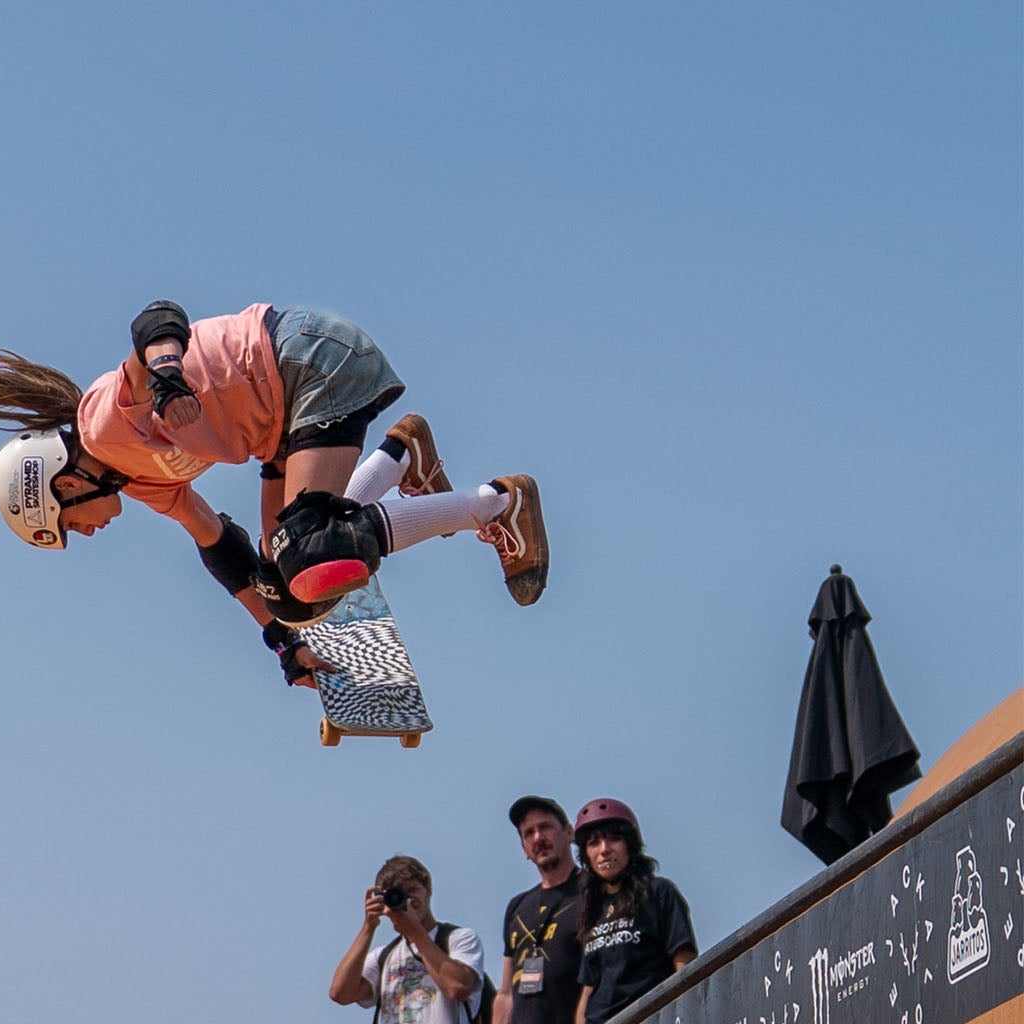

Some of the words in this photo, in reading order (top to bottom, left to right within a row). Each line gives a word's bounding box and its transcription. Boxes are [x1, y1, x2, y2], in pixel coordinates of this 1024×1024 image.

[24, 460, 32, 509] PYRAMID
[829, 941, 876, 988] MONSTER
[951, 928, 986, 967] JARRITOS
[837, 975, 871, 1003] ENERGY
